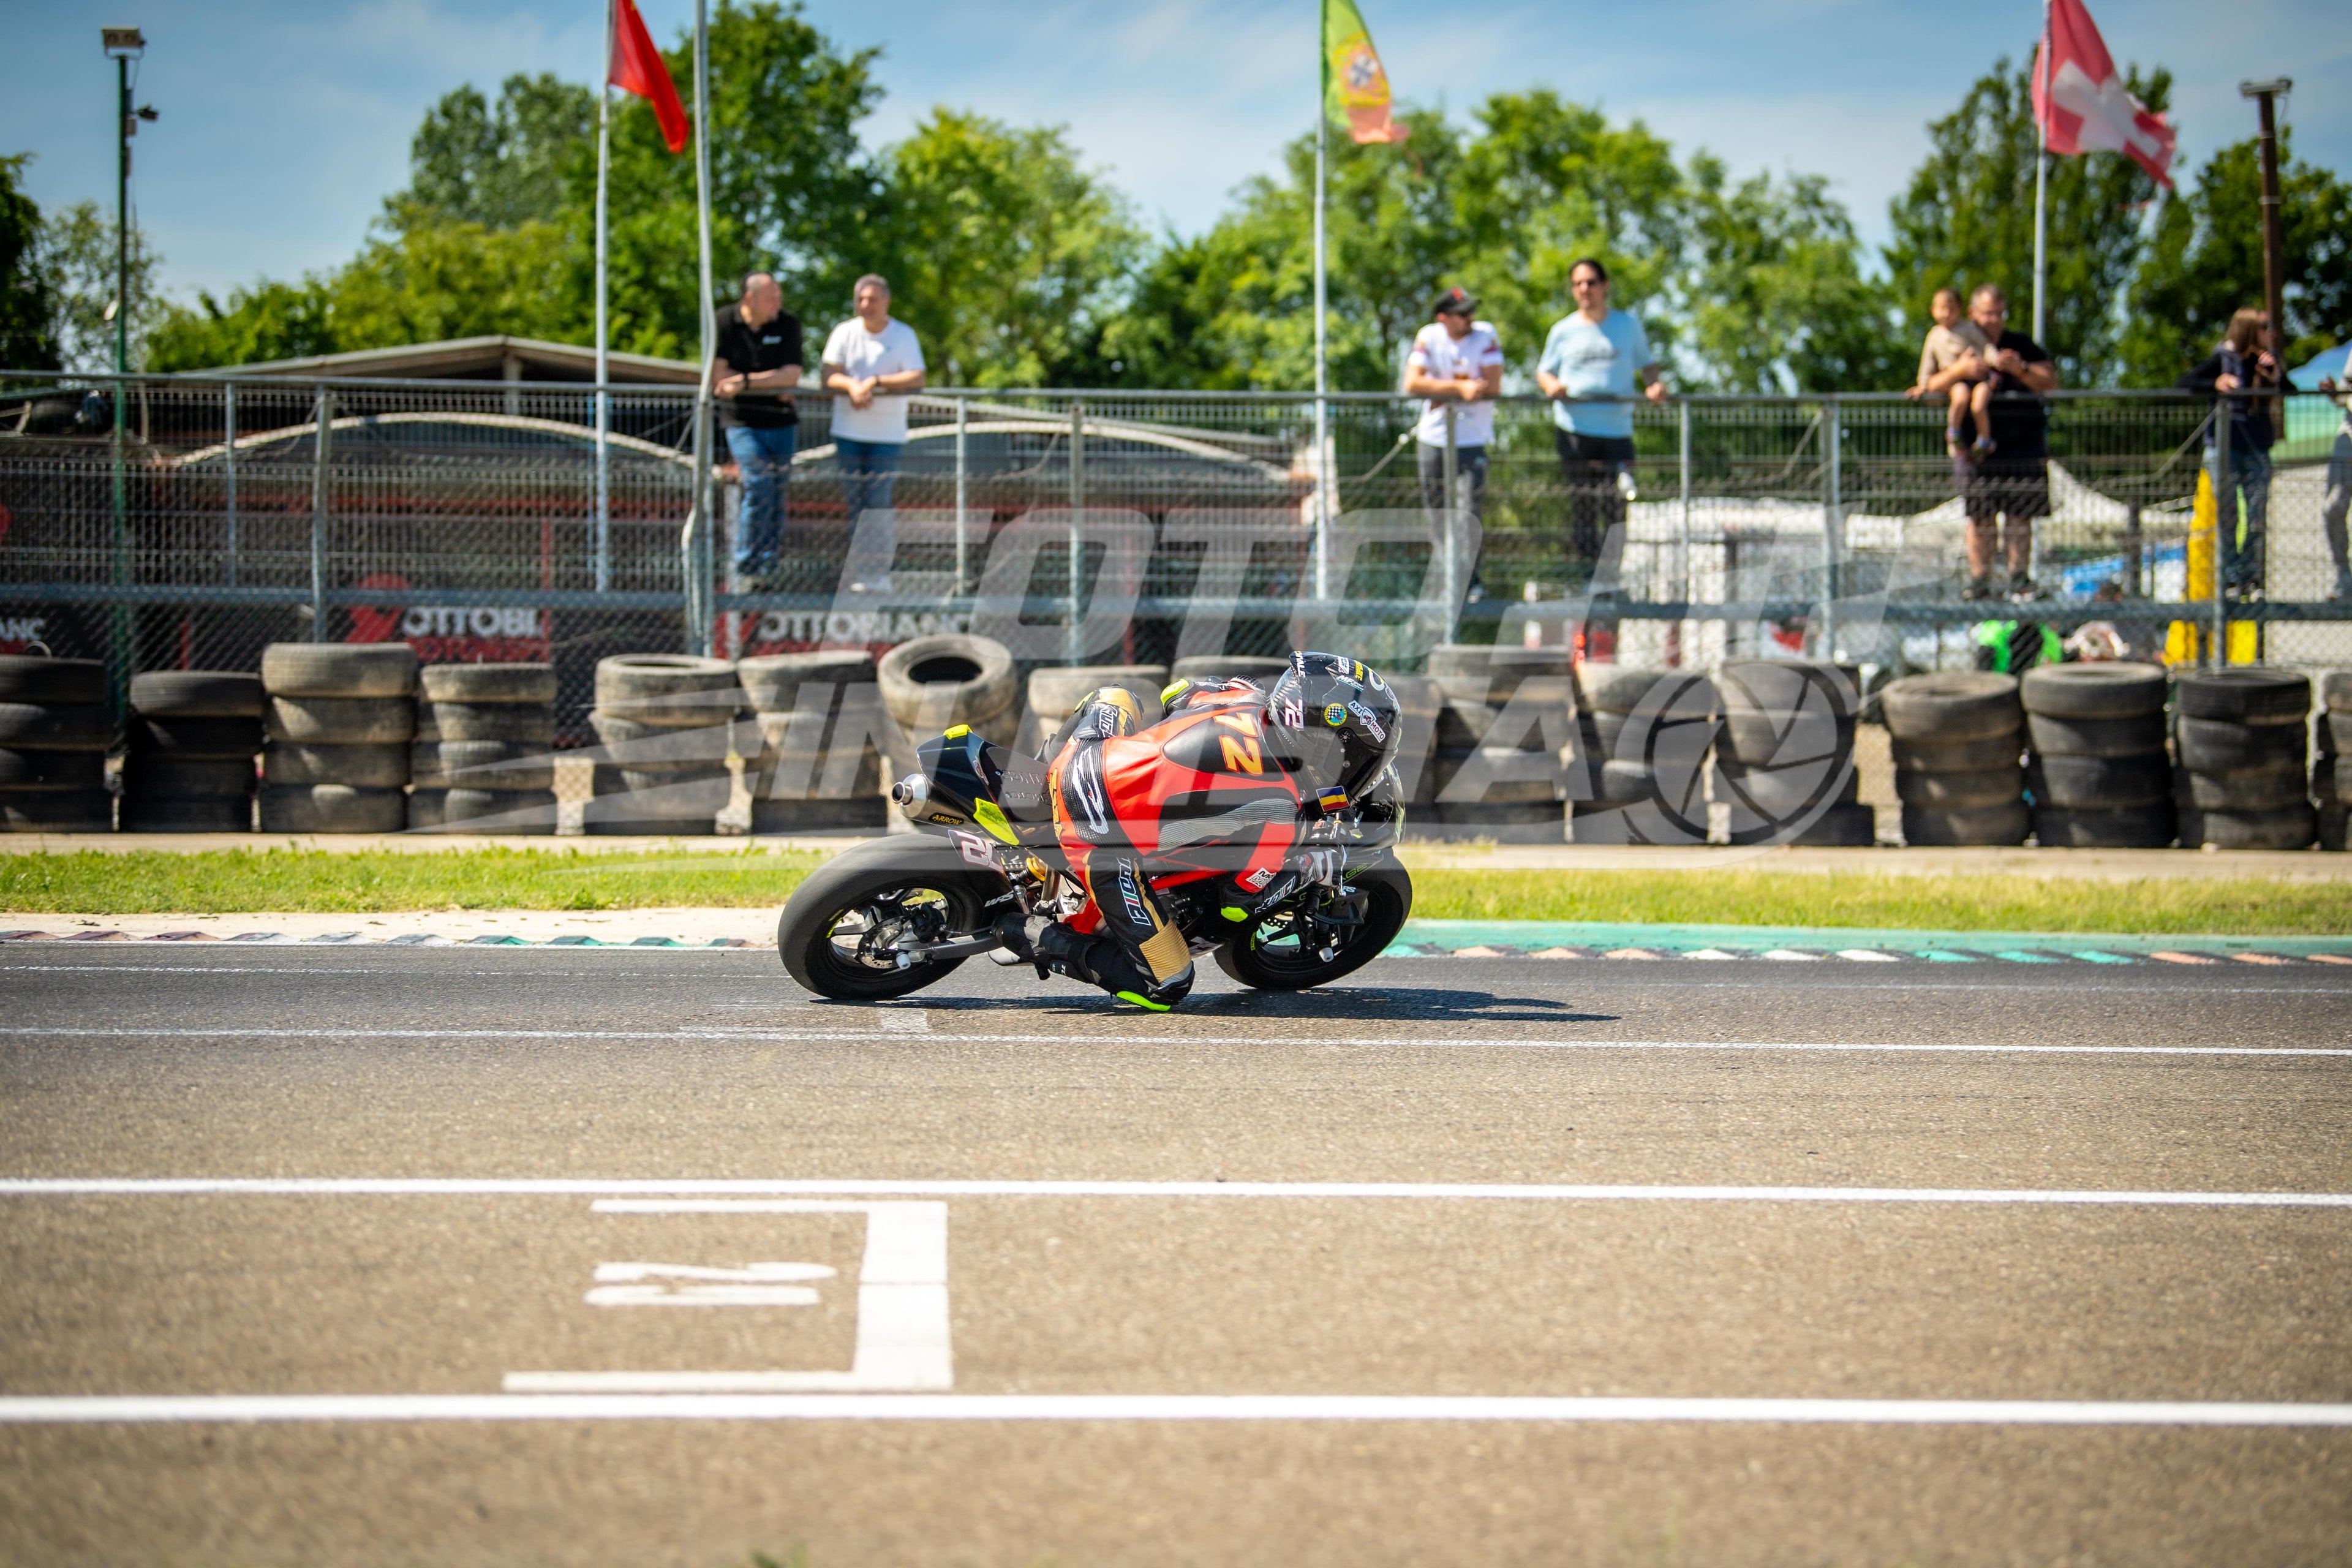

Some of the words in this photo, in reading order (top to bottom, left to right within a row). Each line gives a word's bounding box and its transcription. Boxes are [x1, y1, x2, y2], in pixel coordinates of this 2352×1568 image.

[1284, 696, 1305, 731] 72
[1350, 700, 1363, 715] AXI
[1370, 722, 1385, 741] MOTO
[1212, 711, 1265, 777] 72
[932, 814, 962, 825] ARROW
